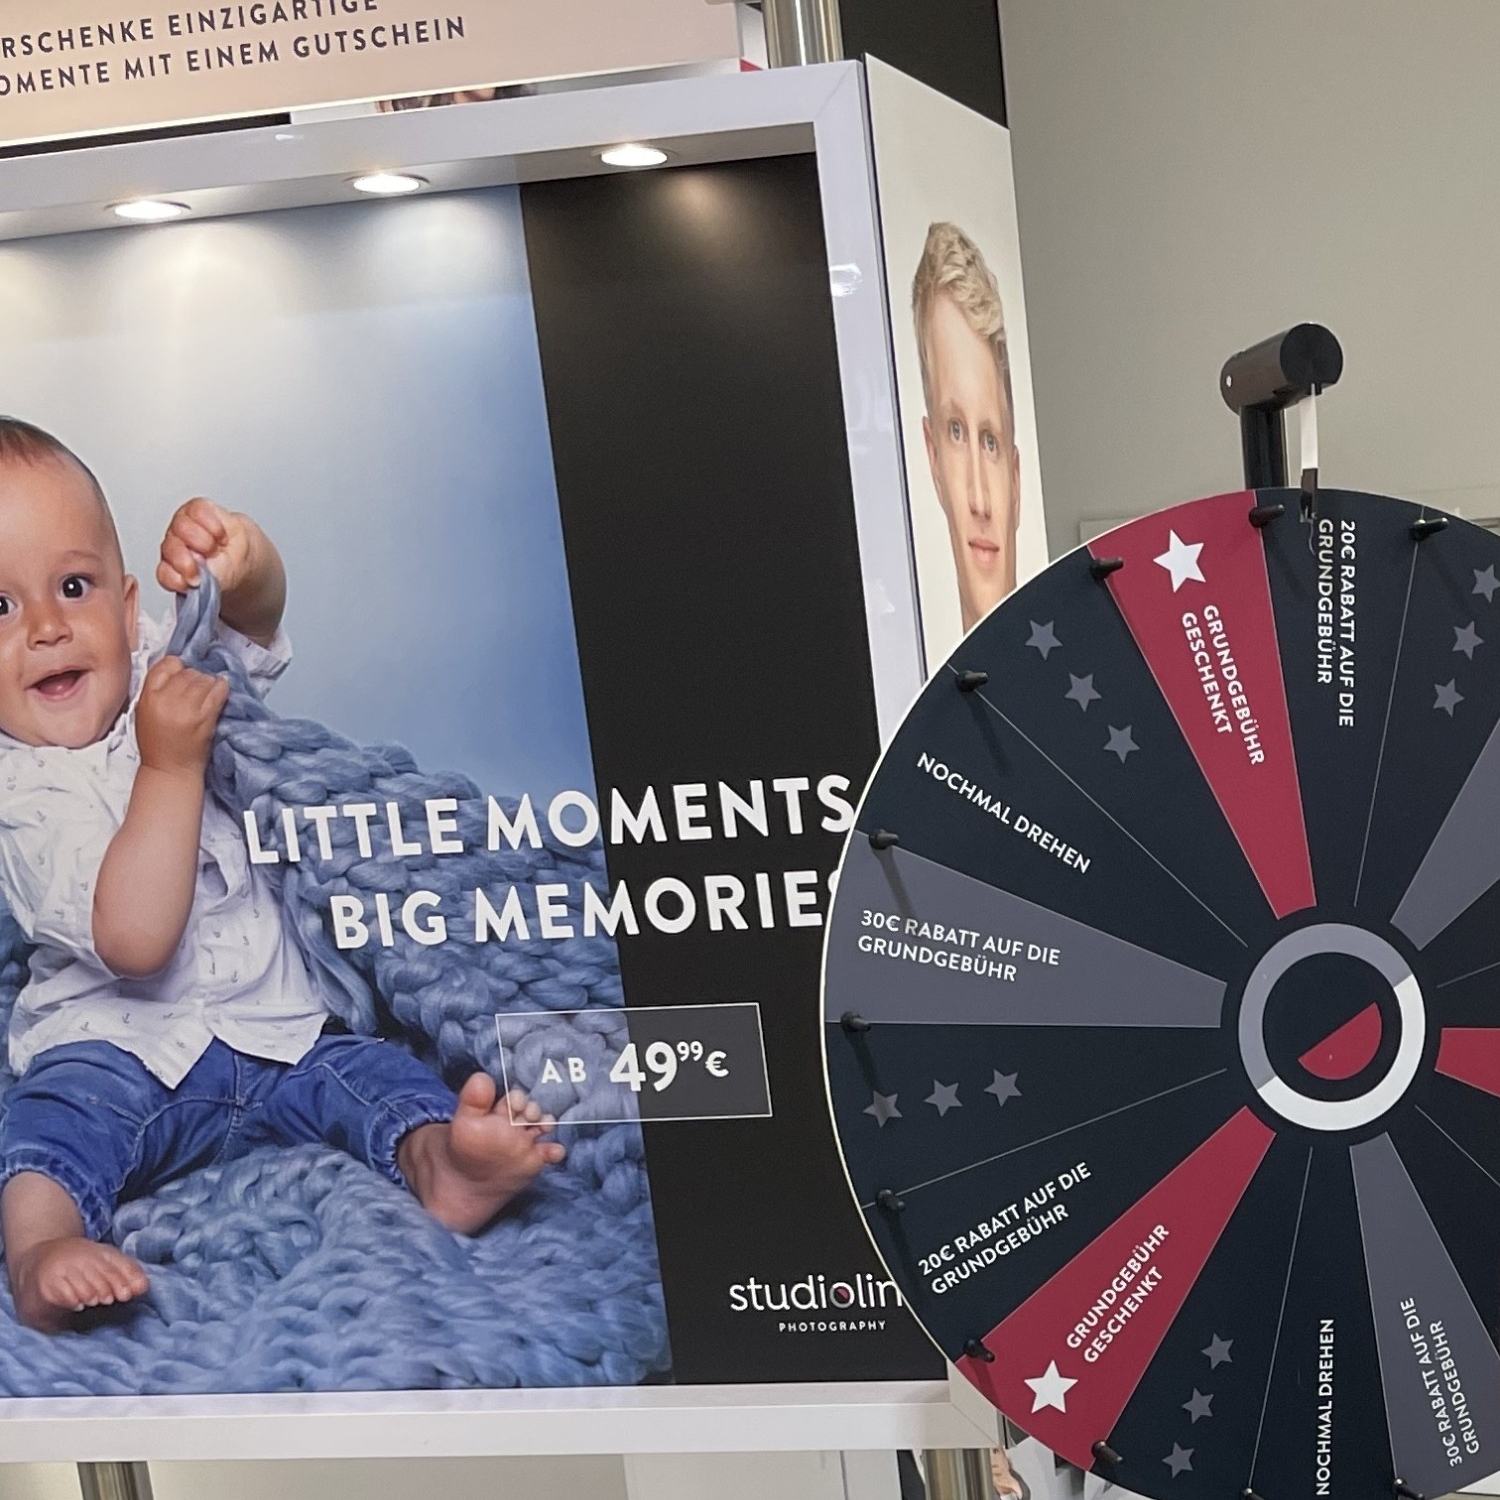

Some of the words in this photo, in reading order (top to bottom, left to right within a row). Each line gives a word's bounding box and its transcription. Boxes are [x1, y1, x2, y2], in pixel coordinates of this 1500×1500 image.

[1, 18, 154, 58] RSCHENKE
[125, 53, 171, 80] MIT
[187, 40, 279, 71] EINEM
[293, 16, 464, 58] GUTSCHEIN
[1341, 520, 1356, 560] 20€
[1317, 519, 1336, 684] GRUNDGEBÜHR
[1340, 565, 1355, 642] RABATT
[1181, 612, 1233, 734] GESCHENKT
[1204, 604, 1265, 765] GRUNDGEBÜHR
[1339, 645, 1354, 688] AUF
[1338, 693, 1354, 727] DIE
[244, 798, 463, 864] LITTLE
[488, 775, 855, 852] MOMENTS
[917, 752, 1010, 825] NOCHMAL
[1014, 815, 1091, 873] DREHEN
[331, 891, 447, 949] BIG
[475, 869, 838, 943] MEMORIE
[861, 910, 900, 931] 30€
[904, 918, 980, 948] RABATT
[982, 936, 1024, 957] AUF
[1027, 944, 1061, 965] DIE
[858, 935, 1017, 981] GRUNDGEBÜHR
[541, 1057, 587, 1084] AB
[918, 1245, 956, 1275] 20€
[954, 1204, 1021, 1253] RABATT
[1023, 1181, 1058, 1214] AUF
[1057, 1162, 1092, 1191] DIE
[931, 1203, 1070, 1294] GRUNDGEBÜHR
[1066, 1224, 1169, 1348] GRUNDGEBÜHR
[1083, 1266, 1163, 1363] GESCHENKT
[1400, 1297, 1421, 1330] DIE
[779, 1320, 886, 1332] PHOTOGRAPHY
[1318, 1318, 1335, 1396] DREHEN
[1410, 1332, 1432, 1364] AUF
[1422, 1370, 1452, 1432] RABATT
[1430, 1320, 1480, 1454] GRUNDGEBÜHR
[1315, 1398, 1334, 1496] NOCHMAL
[1442, 1433, 1463, 1467] 30€
